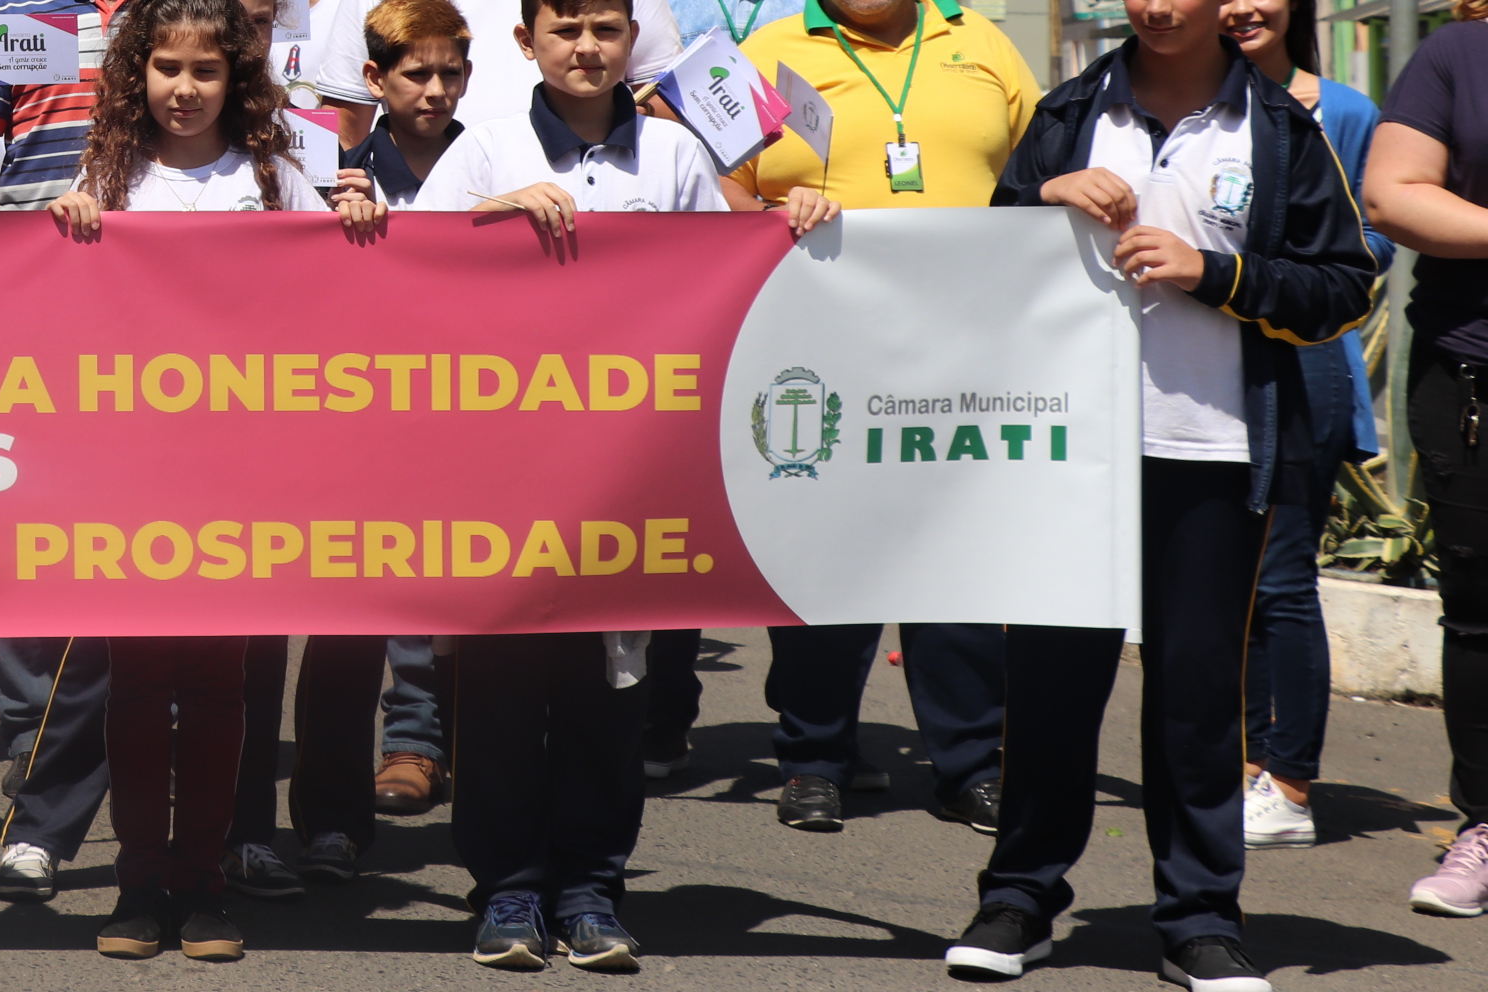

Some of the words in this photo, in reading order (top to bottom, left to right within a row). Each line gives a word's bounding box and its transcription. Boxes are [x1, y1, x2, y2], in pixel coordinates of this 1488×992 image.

[0, 33, 46, 52] Irati
[13, 63, 47, 71] corrupção
[708, 75, 745, 120] Irati
[78, 352, 702, 413] HONESTIDADE
[867, 394, 953, 416] Câmara
[960, 391, 1069, 417] Municipal
[866, 424, 1068, 463] IRATI
[16, 518, 714, 581] PROSPERIDADE.
